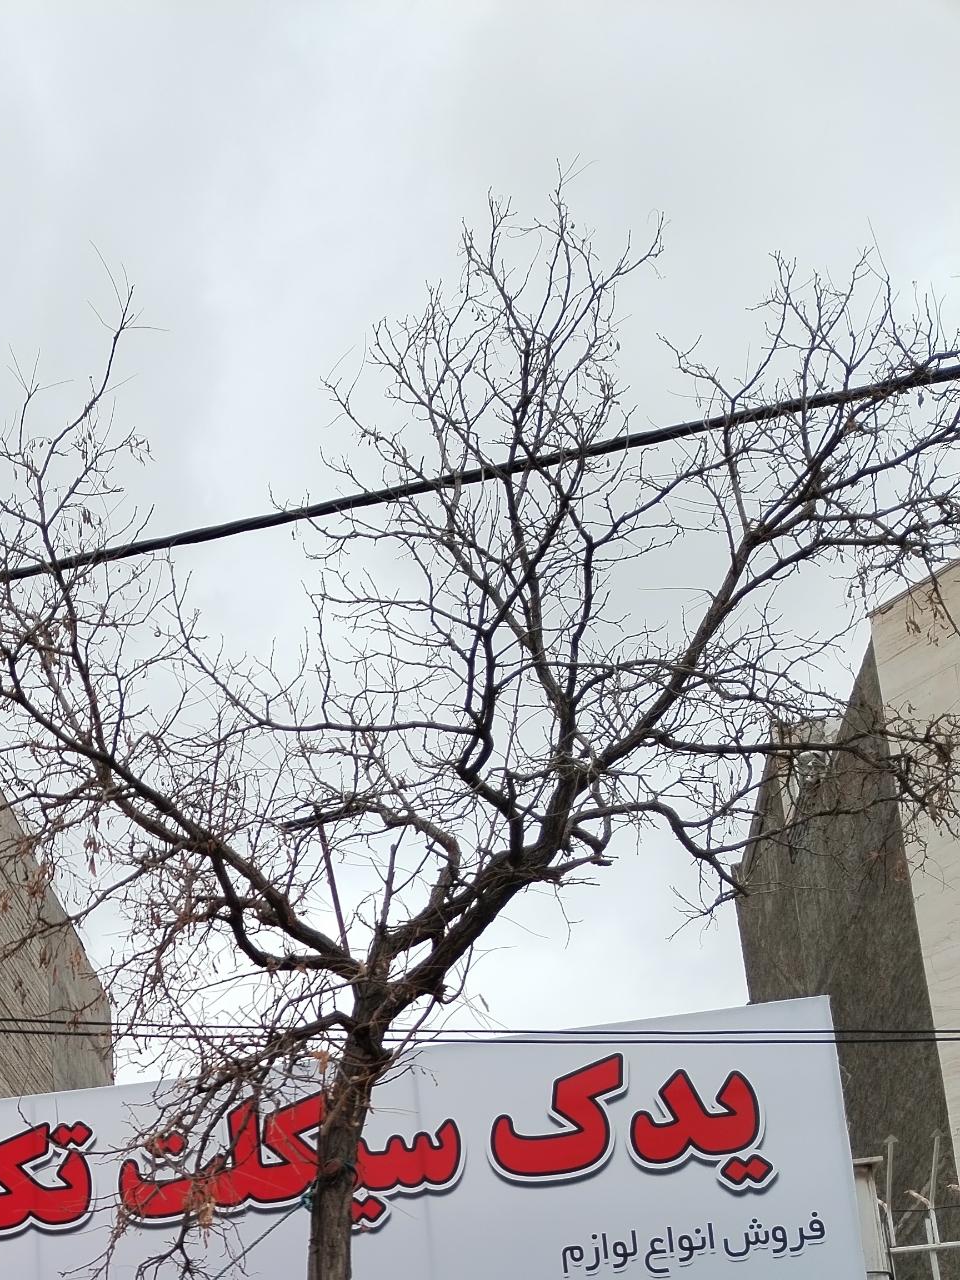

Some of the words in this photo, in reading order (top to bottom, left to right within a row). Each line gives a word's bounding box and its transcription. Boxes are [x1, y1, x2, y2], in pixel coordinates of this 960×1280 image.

[490, 1051, 775, 1186] یدک
[118, 1088, 462, 1224] سیکلت
[561, 1230, 638, 1273] لوازم
[645, 1222, 715, 1273] انواع
[724, 1211, 826, 1258] فروش
